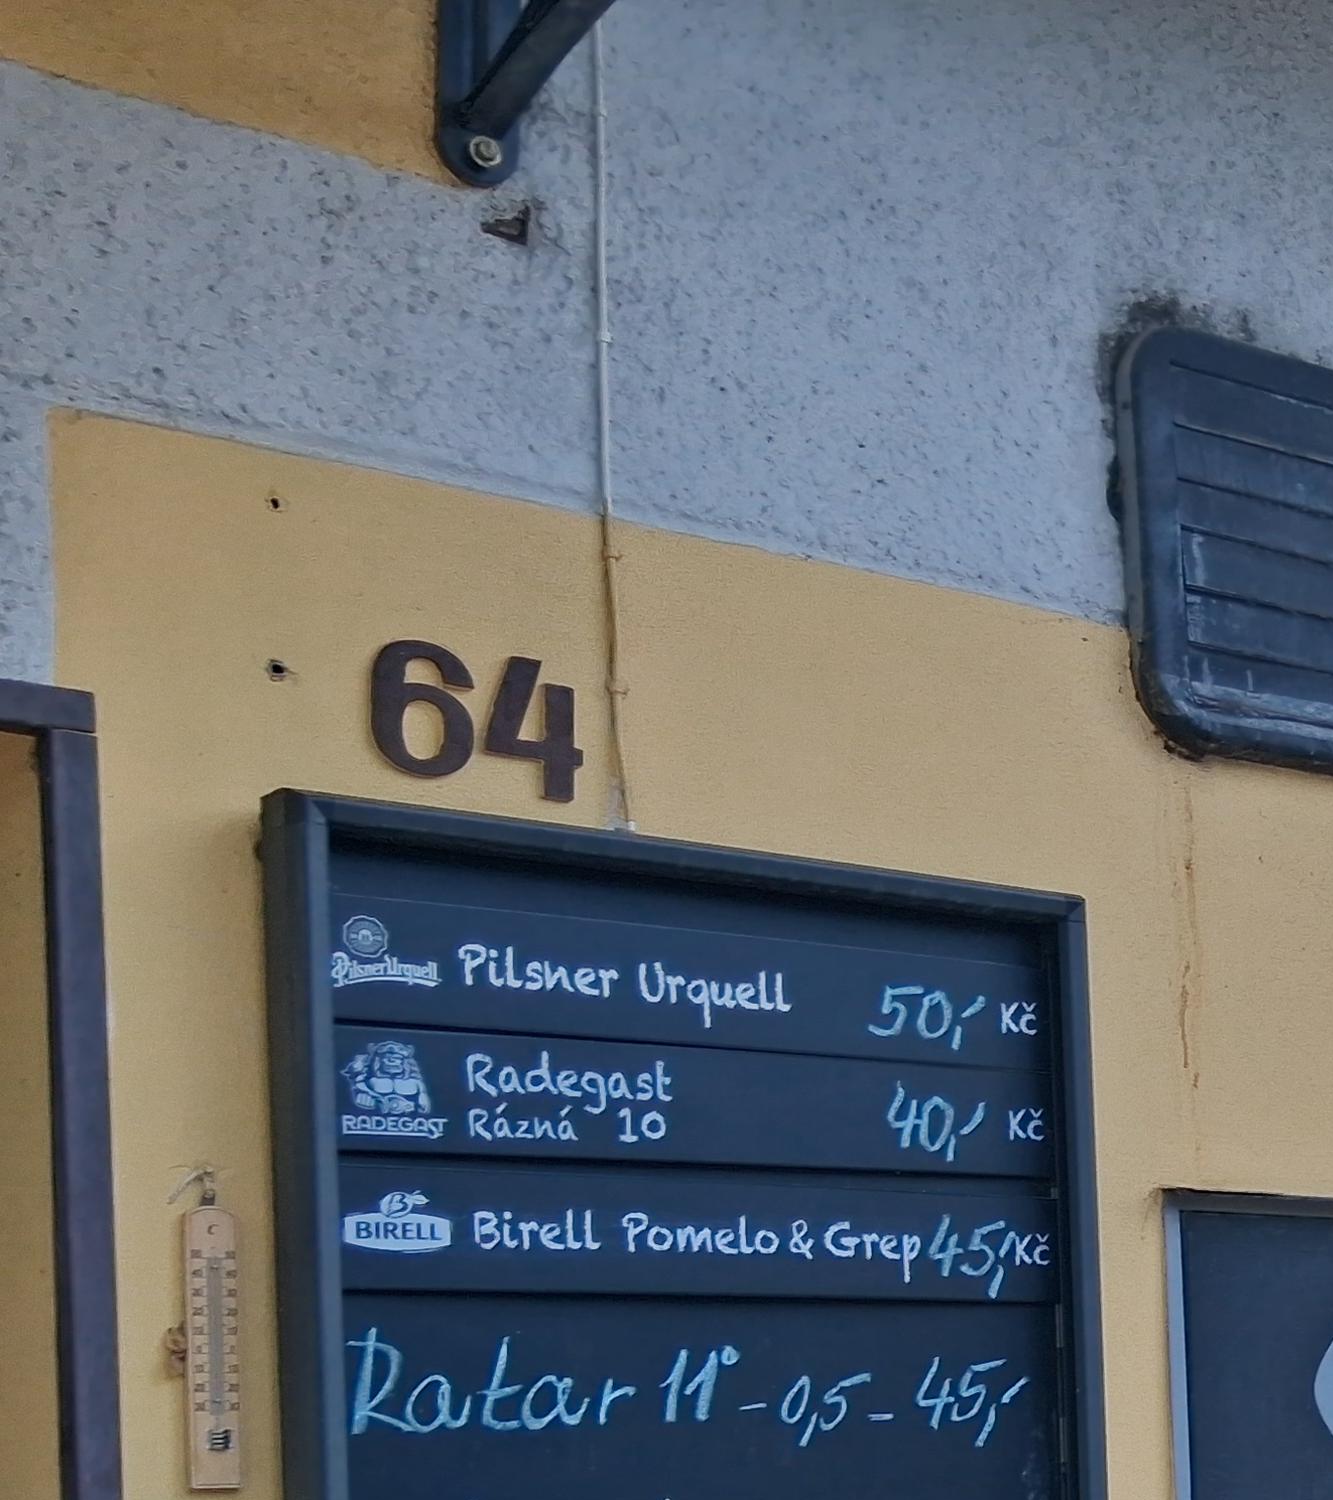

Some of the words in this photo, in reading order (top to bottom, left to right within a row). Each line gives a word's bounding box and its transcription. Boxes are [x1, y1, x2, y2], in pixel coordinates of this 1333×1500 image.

[370, 639, 584, 803] 64
[458, 943, 619, 998] Pilsner
[638, 961, 792, 1028] Urquell
[1000, 1001, 1038, 1036] Kč
[466, 1051, 673, 1114] Radegast
[342, 1114, 448, 1139] RADEGAST
[467, 1101, 578, 1142] Rázná
[618, 1106, 667, 1144] 10
[1008, 1108, 1046, 1141] Kč
[355, 1221, 443, 1241] BIRELL
[473, 1209, 601, 1251] Birell
[622, 1211, 779, 1256] Pomelo
[788, 1223, 814, 1260] &
[823, 1221, 922, 1284] Grep
[1013, 1233, 1051, 1266] Kč
[348, 1327, 636, 1435] Ratar
